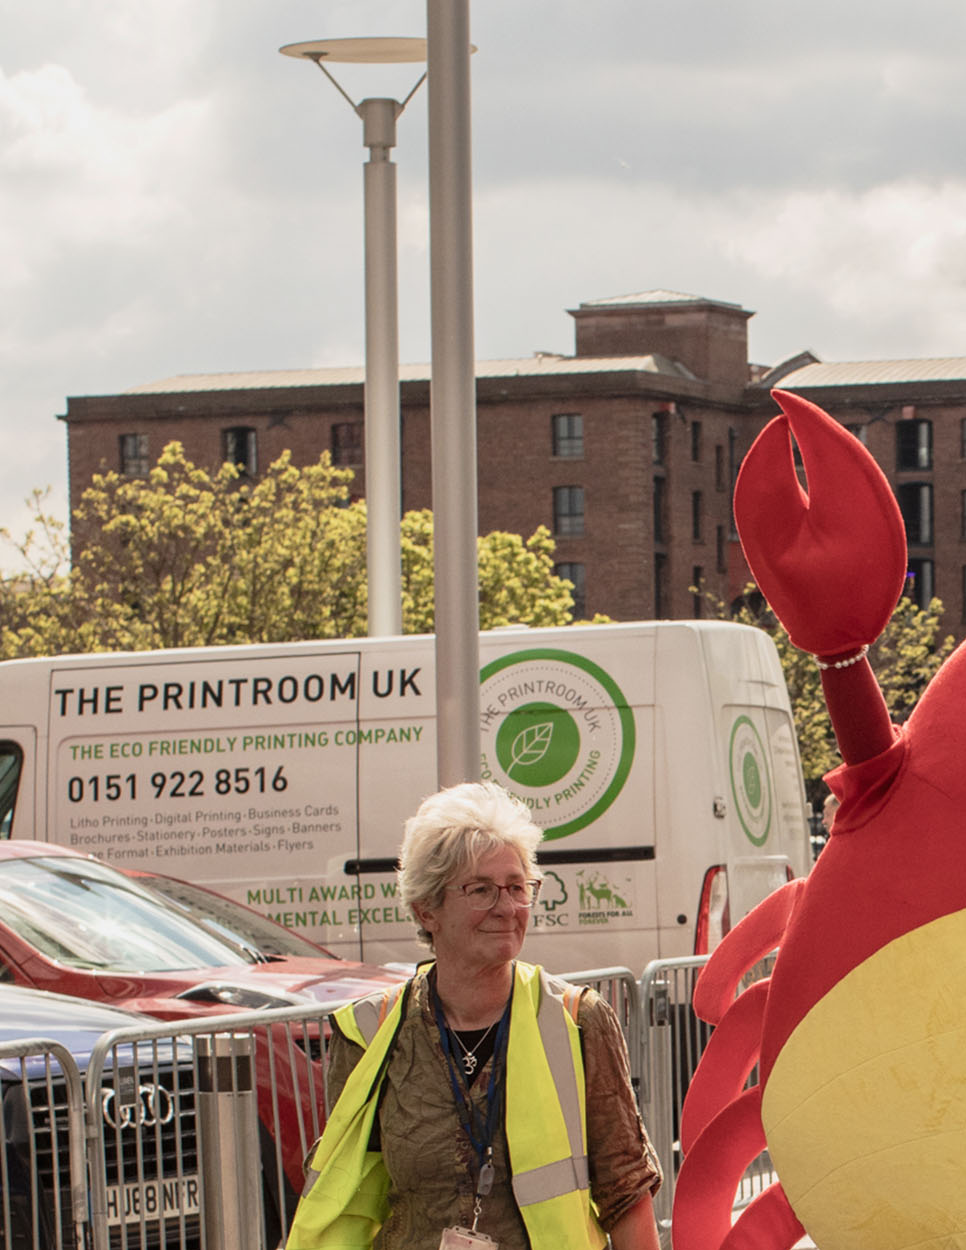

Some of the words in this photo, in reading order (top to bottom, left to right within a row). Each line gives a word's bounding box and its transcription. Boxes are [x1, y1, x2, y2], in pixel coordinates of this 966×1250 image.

[54, 685, 124, 716] THE
[138, 673, 356, 712] PRINTROOM
[372, 668, 422, 698] UK
[498, 680, 588, 710] PRINTROOM
[583, 708, 602, 733] UK
[70, 744, 104, 761] THE
[110, 741, 143, 758] ECO
[149, 737, 237, 756] FRIENDLY
[243, 732, 329, 751] PRINTING
[334, 726, 423, 746] COMPANY
[68, 774, 137, 802] 0151
[151, 770, 204, 799] 922
[215, 765, 288, 796] 8516
[554, 750, 601, 805] PRINTING
[70, 817, 99, 830] Litho
[102, 815, 148, 831] Printing
[154, 812, 192, 828] Digital
[195, 809, 242, 825] Printing
[248, 807, 301, 821] Business
[304, 804, 339, 817] Cards
[70, 831, 131, 846] Brochures
[136, 828, 196, 844] Stationery
[202, 825, 247, 838] Posters
[253, 823, 286, 839] Signs
[292, 820, 342, 834] Banners
[107, 848, 150, 861] Format
[155, 845, 213, 858] Exhibition
[215, 841, 271, 855] Materials
[277, 838, 314, 853] Flyers
[247, 888, 303, 905] MULTI
[308, 883, 376, 902] AWARD
[533, 914, 569, 928] FSC
